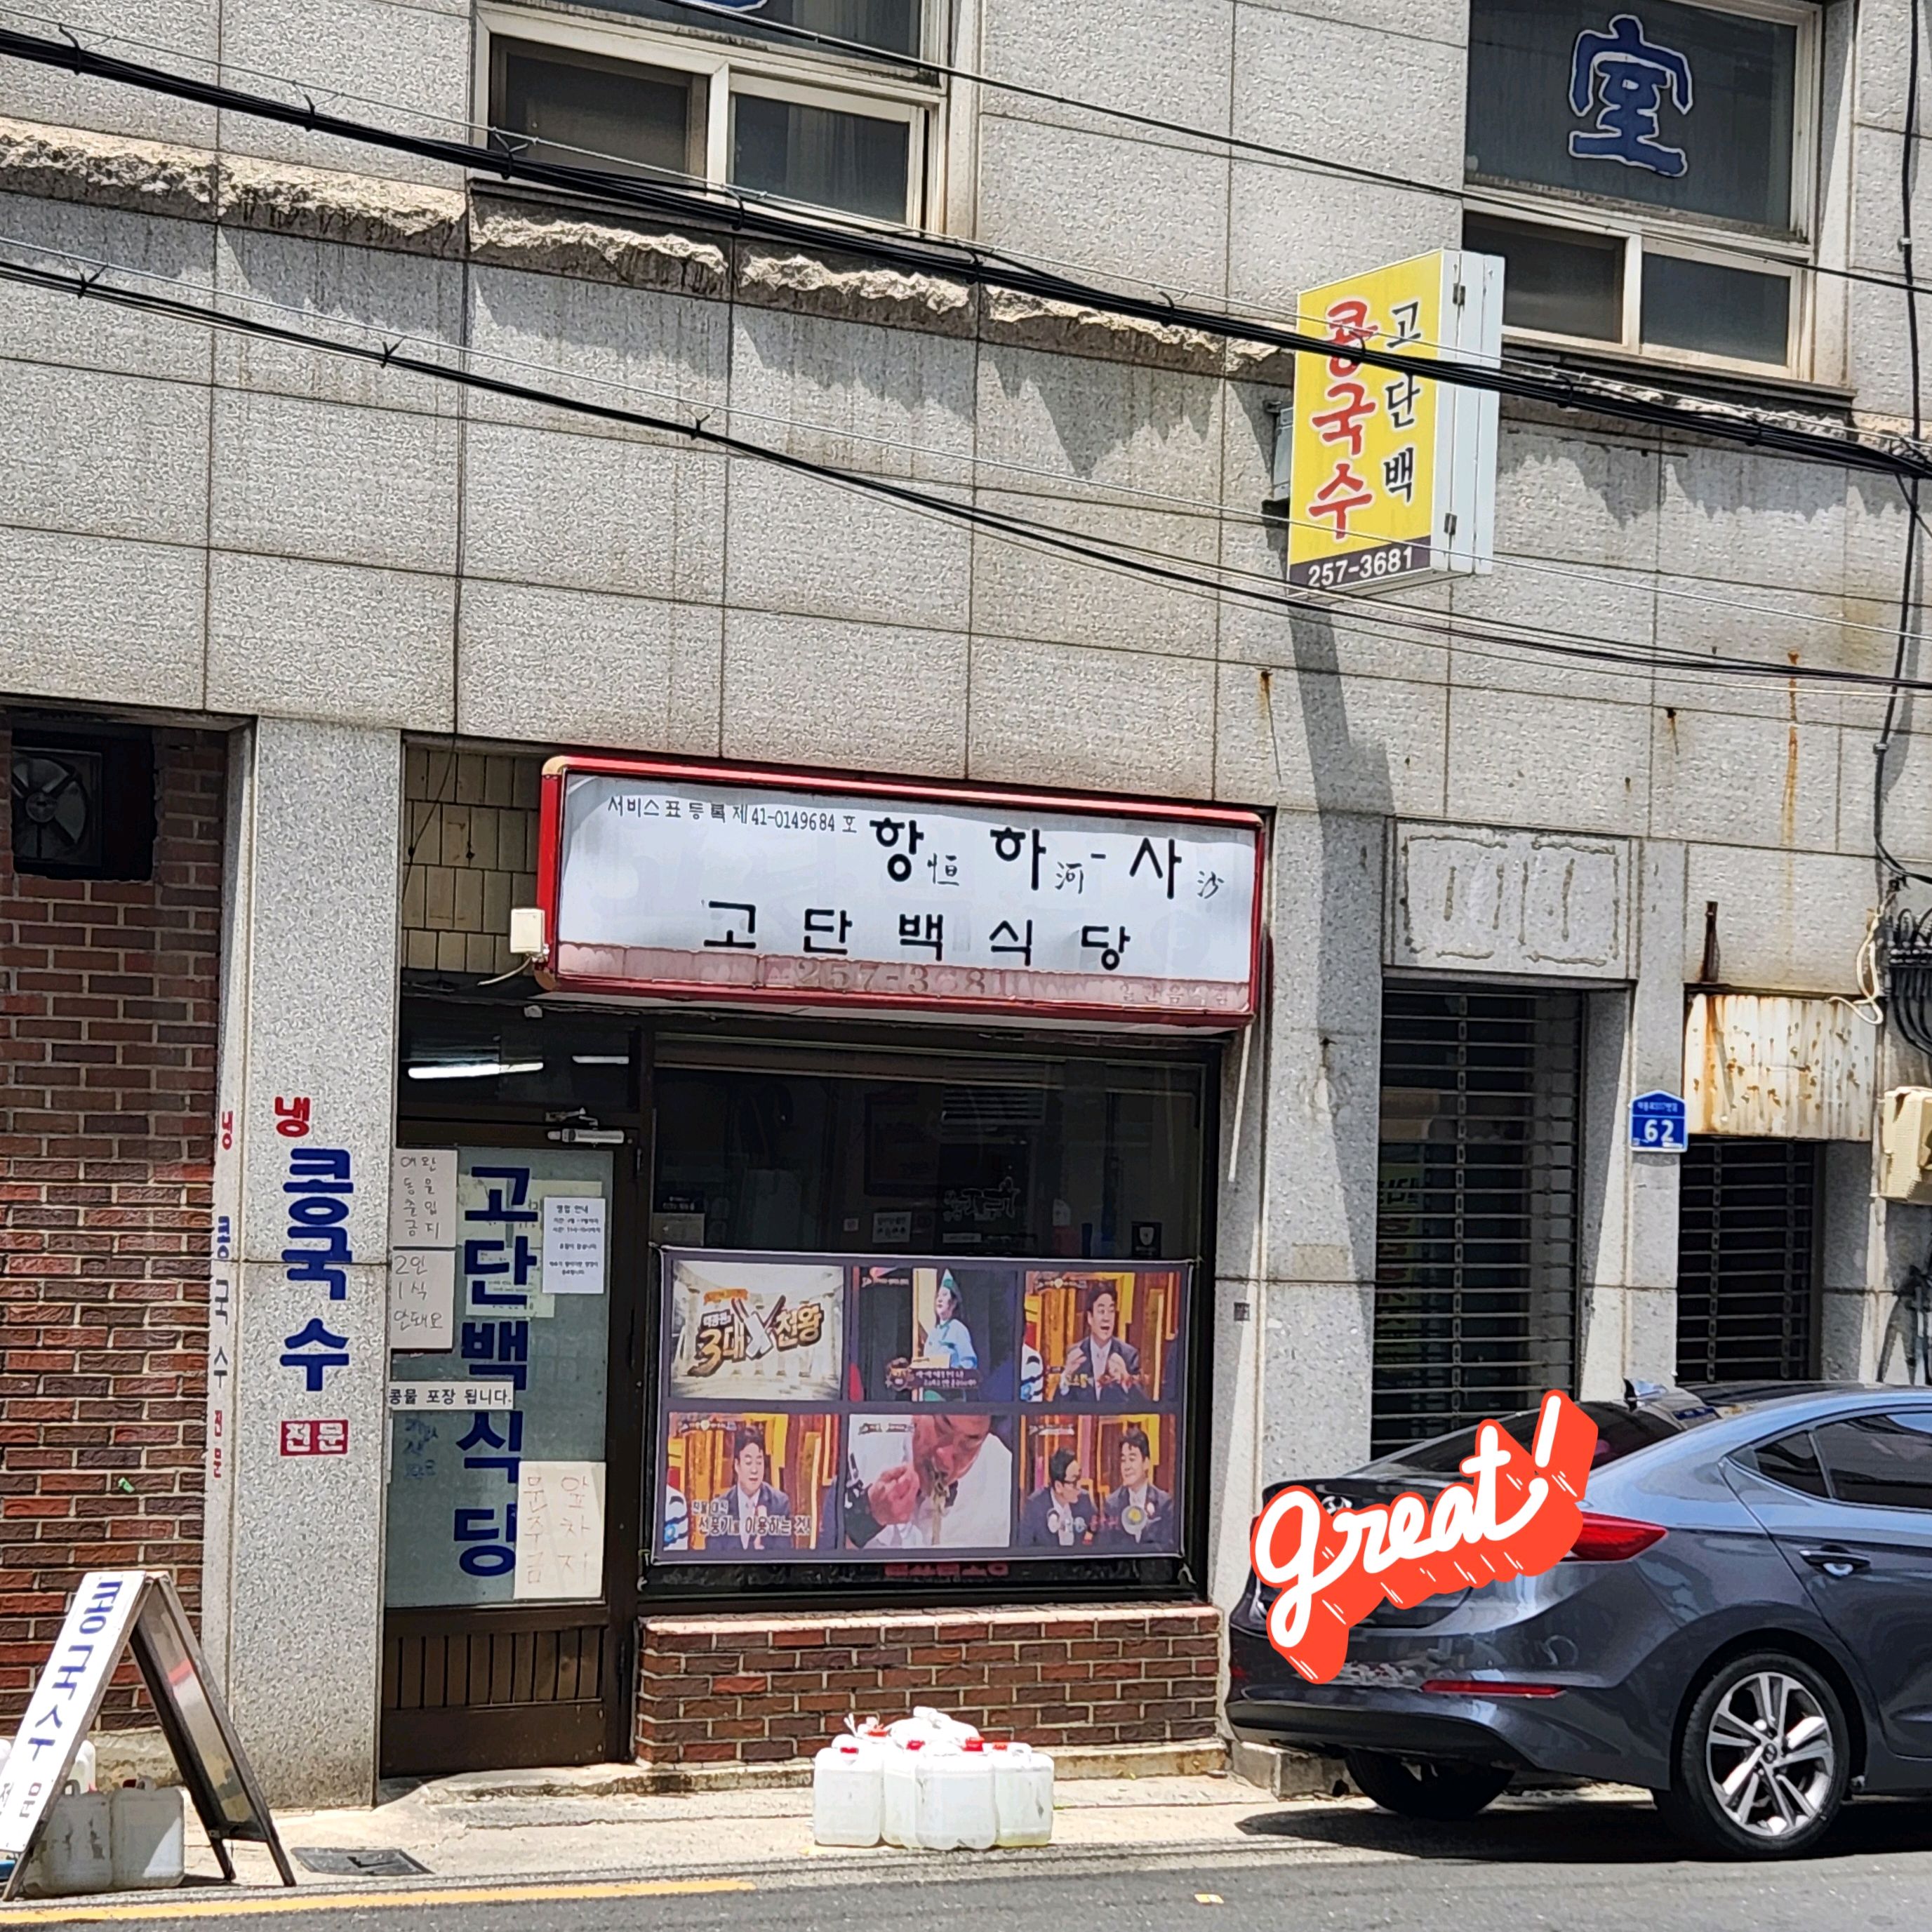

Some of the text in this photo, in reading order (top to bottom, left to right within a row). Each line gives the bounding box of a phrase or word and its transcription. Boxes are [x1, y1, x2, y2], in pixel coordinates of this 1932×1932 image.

[1308, 300, 1379, 540] 콩국수
[1383, 300, 1422, 502] 고단백
[1307, 545, 1413, 587] 257-3681
[1644, 1119, 1674, 1142] 62
[280, 1148, 354, 1392] 콩국수
[283, 1420, 347, 1455] 전문
[389, 1388, 512, 1406] 콩물 포장 됩니다.
[27, 1580, 124, 1762] 콩국수
